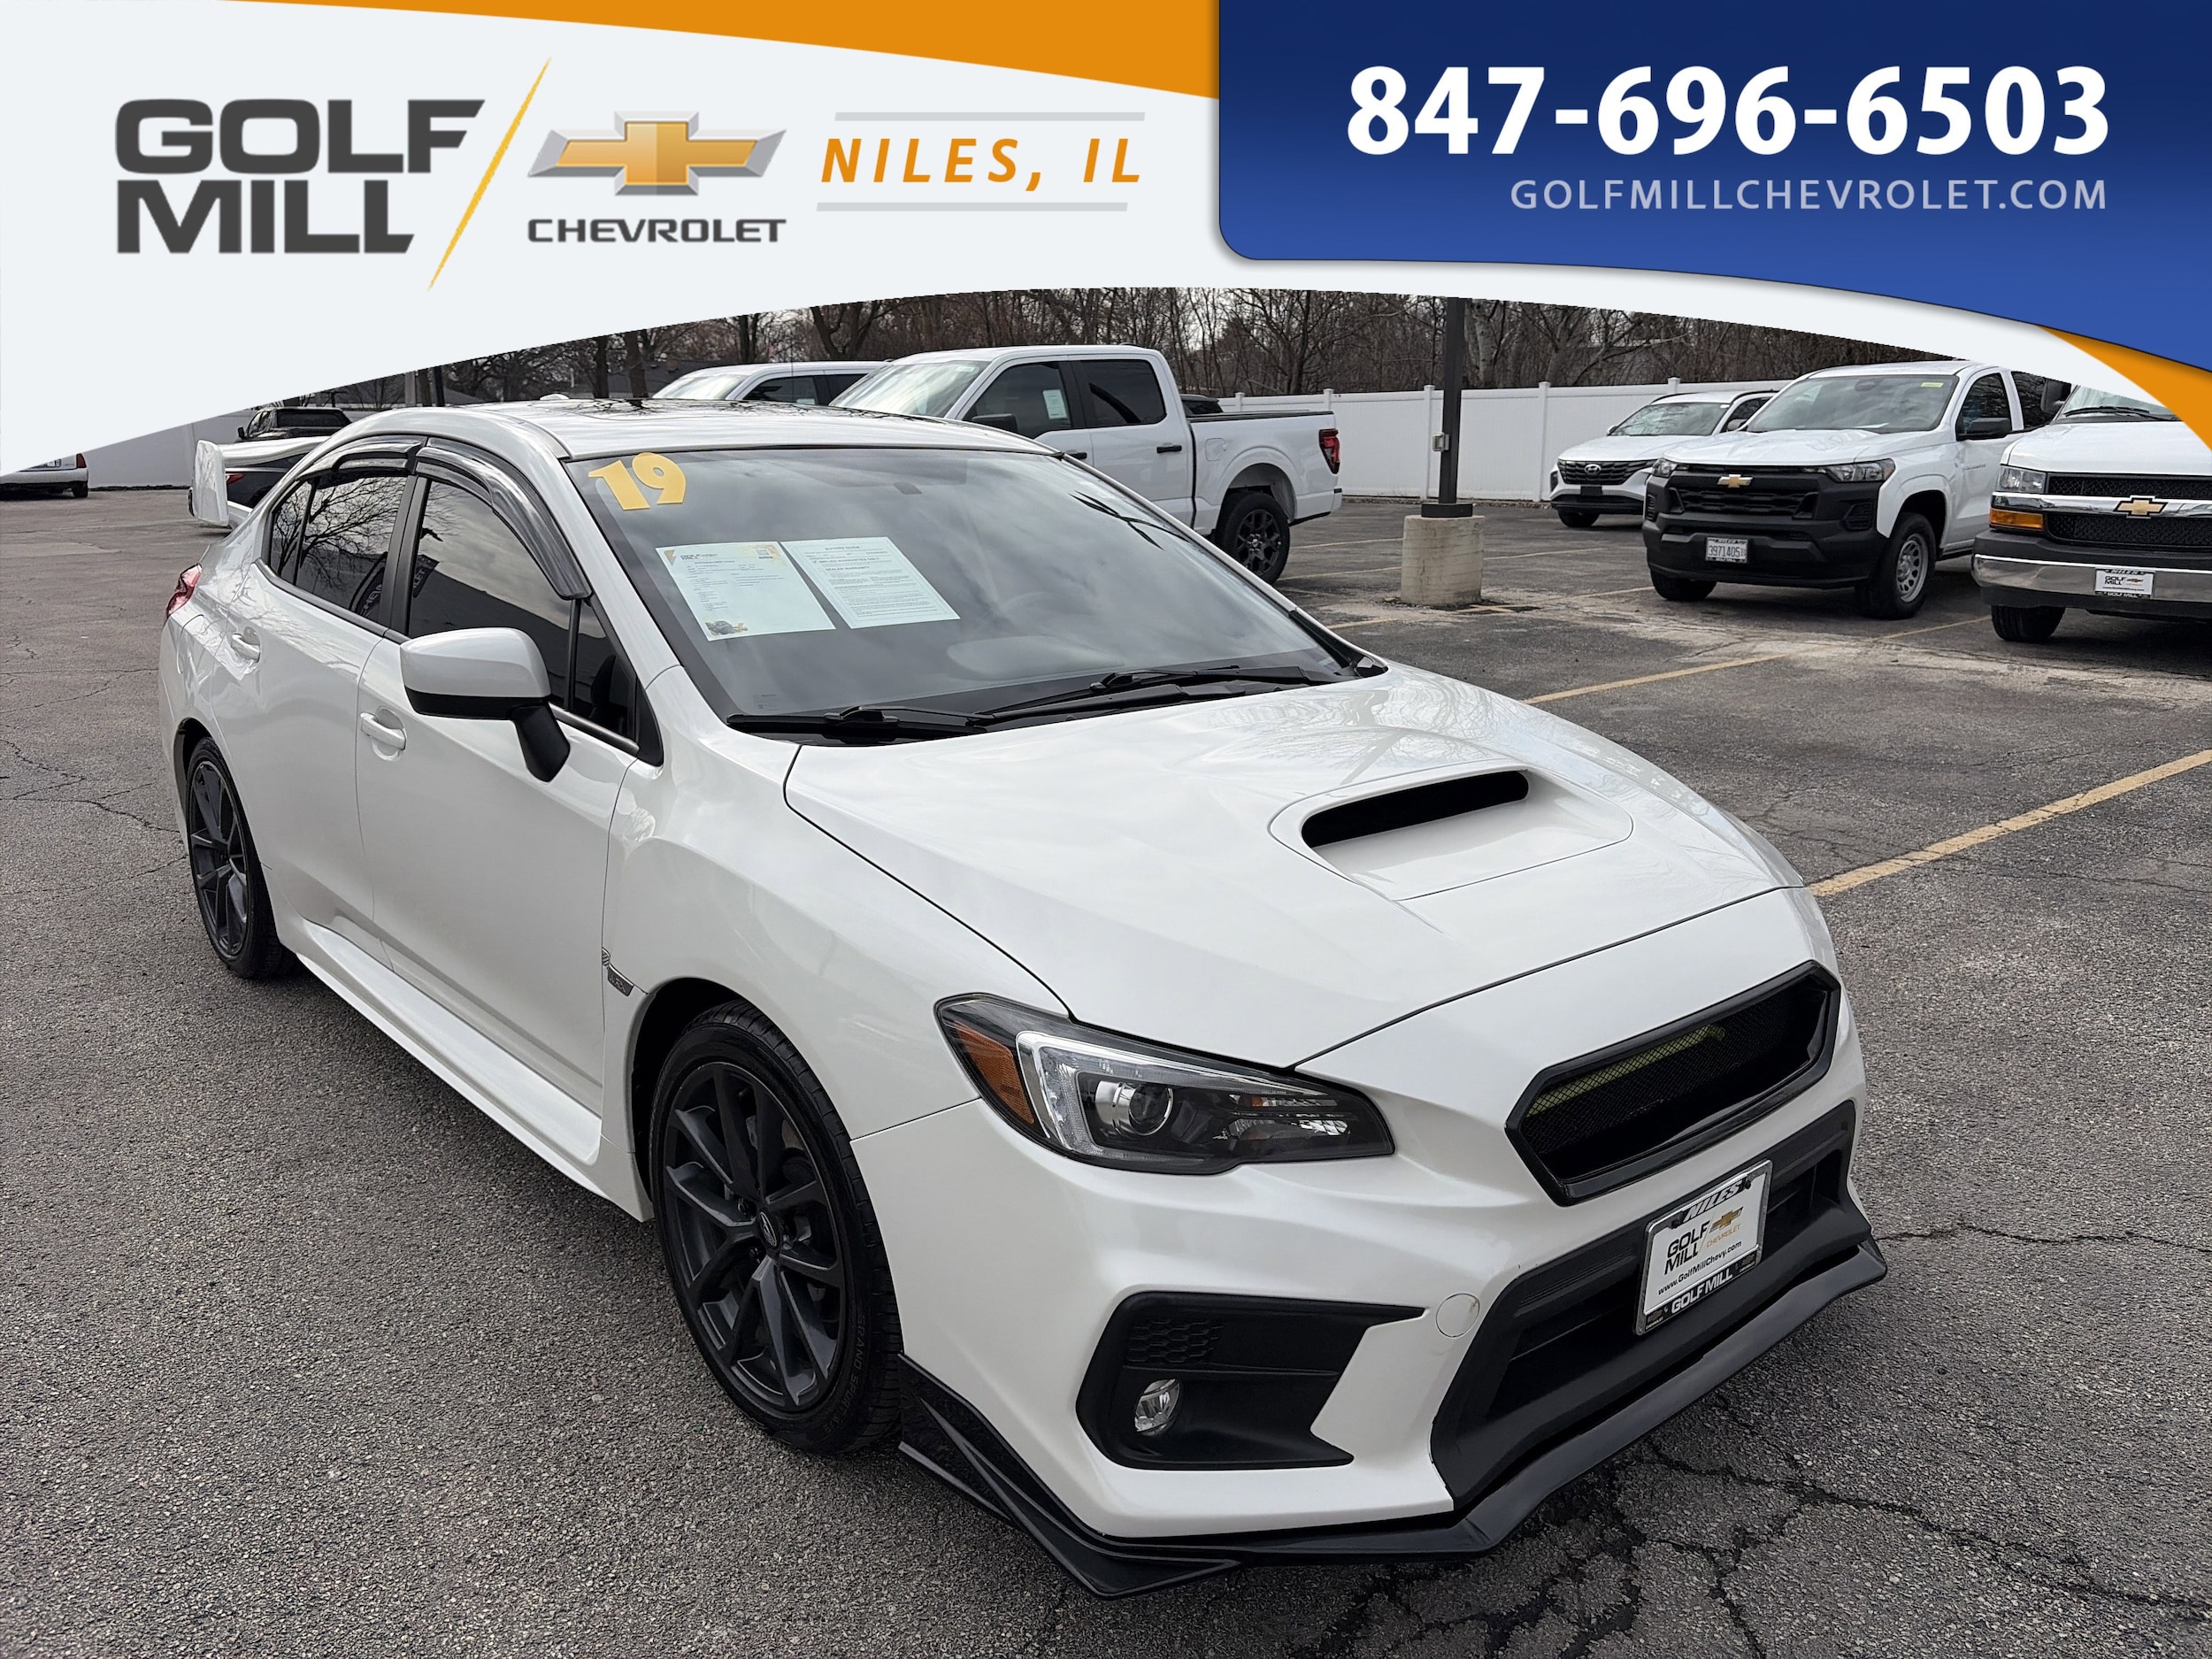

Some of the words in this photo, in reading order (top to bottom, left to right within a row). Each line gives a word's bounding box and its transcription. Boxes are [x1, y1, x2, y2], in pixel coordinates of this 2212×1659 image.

[588, 452, 687, 511] 19
[1709, 545, 1740, 557] 3971405
[1683, 1179, 1742, 1223] NILES
[1667, 1220, 1710, 1258] GOLF
[1706, 1223, 1742, 1248] CHEVROLET
[1658, 1240, 1742, 1295] www.GolfMillChevy.com
[1664, 1242, 1700, 1275] MILL
[1671, 1286, 1706, 1314] GOLF
[1704, 1268, 1733, 1294] MILL
